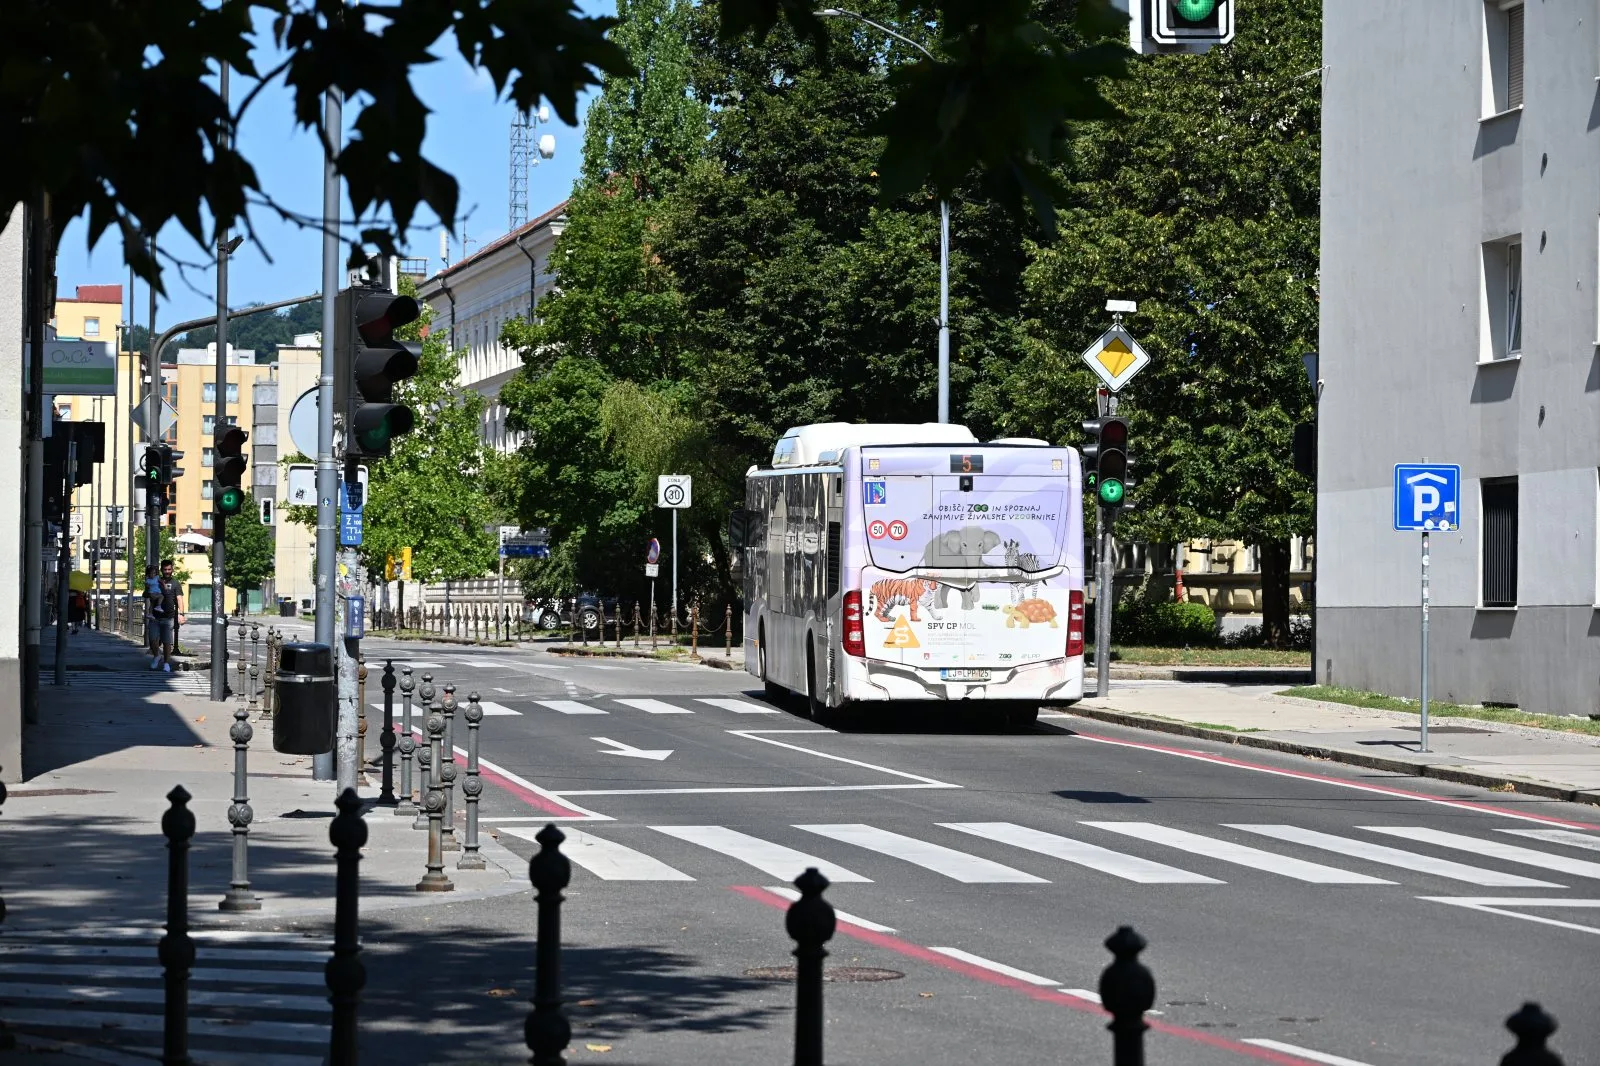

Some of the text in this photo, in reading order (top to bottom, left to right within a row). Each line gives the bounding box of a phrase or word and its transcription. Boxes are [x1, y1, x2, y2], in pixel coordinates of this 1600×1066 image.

[962, 455, 971, 472] 5
[668, 489, 681, 500] 30
[938, 503, 964, 512] OBIŠČI
[967, 503, 989, 513] ZOO
[1004, 504, 1041, 512] SPOZNAJ
[1413, 485, 1440, 522] P
[922, 513, 965, 521] ZANIMIVE
[967, 512, 1006, 521] ŽIVALSKE
[873, 525, 883, 535] 50
[893, 525, 903, 535] 70
[927, 622, 944, 630] SPV
[946, 622, 958, 630] CP
[947, 669, 957, 678] LJ
